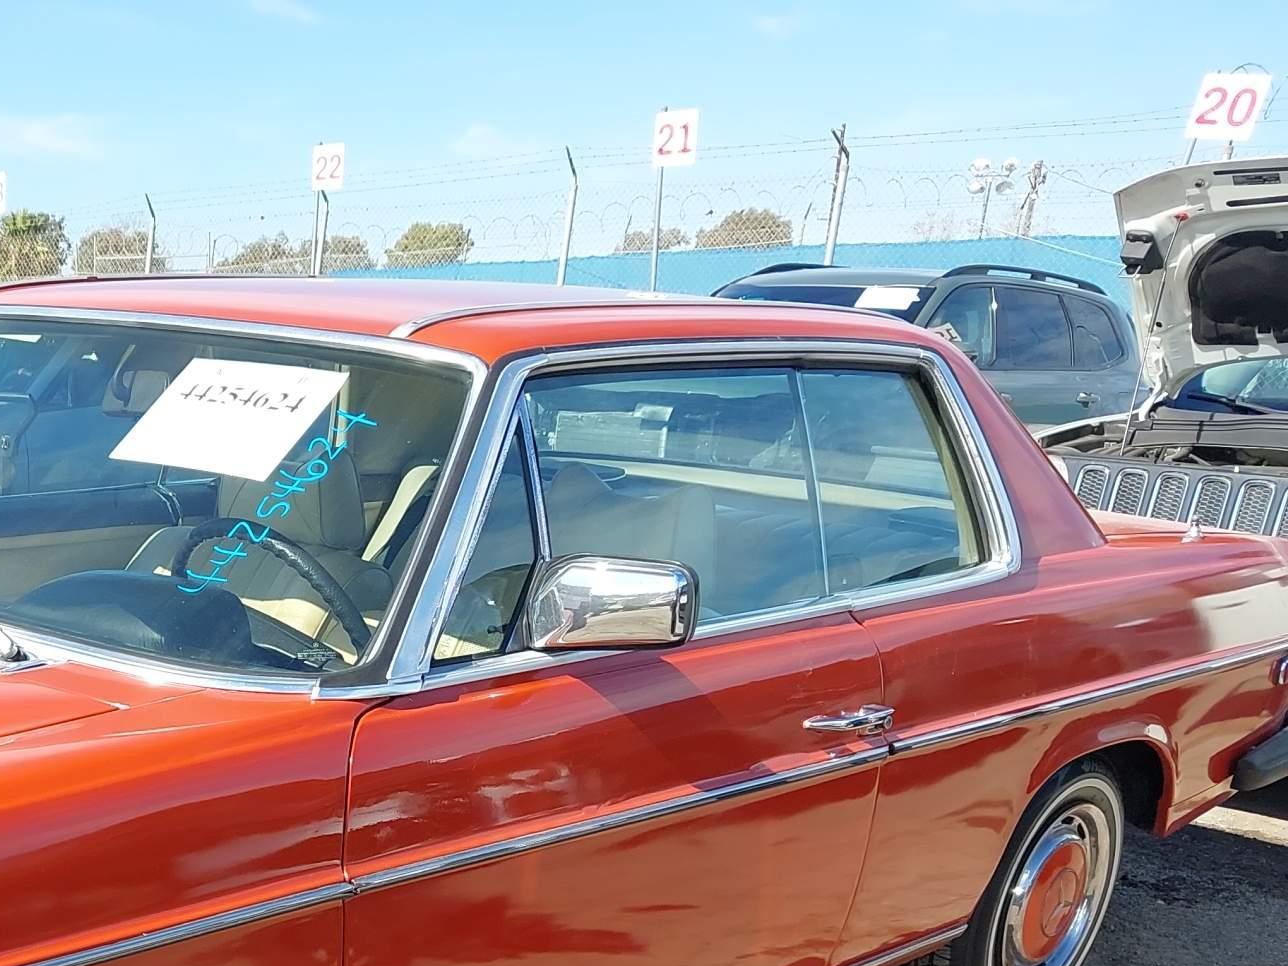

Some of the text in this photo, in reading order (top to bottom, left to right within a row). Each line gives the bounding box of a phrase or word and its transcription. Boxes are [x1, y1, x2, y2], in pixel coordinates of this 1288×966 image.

[1195, 87, 1257, 126] 20
[657, 121, 691, 155] 21
[316, 154, 341, 180] 22
